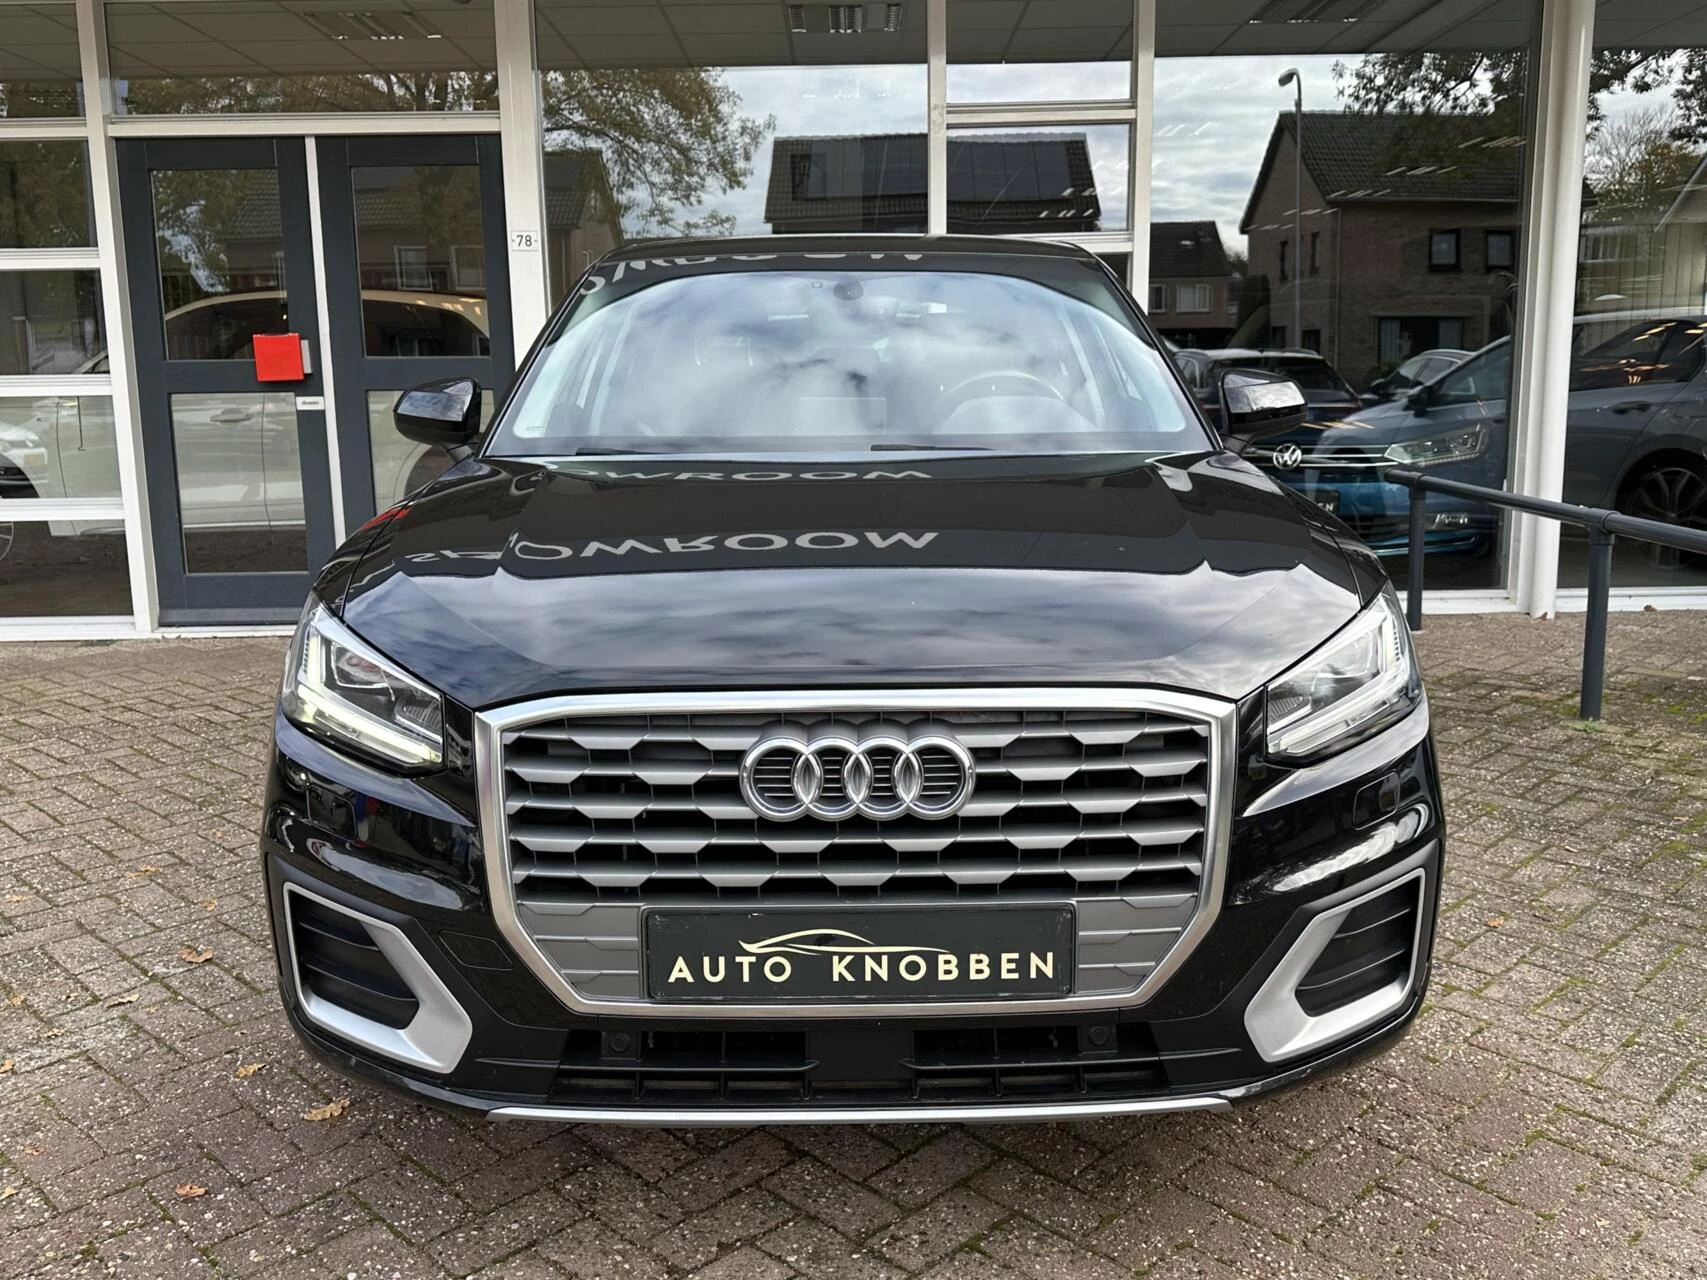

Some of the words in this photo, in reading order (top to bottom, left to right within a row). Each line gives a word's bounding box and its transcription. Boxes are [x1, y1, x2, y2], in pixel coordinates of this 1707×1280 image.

[516, 234, 532, 247] 78
[668, 955, 792, 983] AUTO
[832, 951, 1054, 982] KNOBBEN
